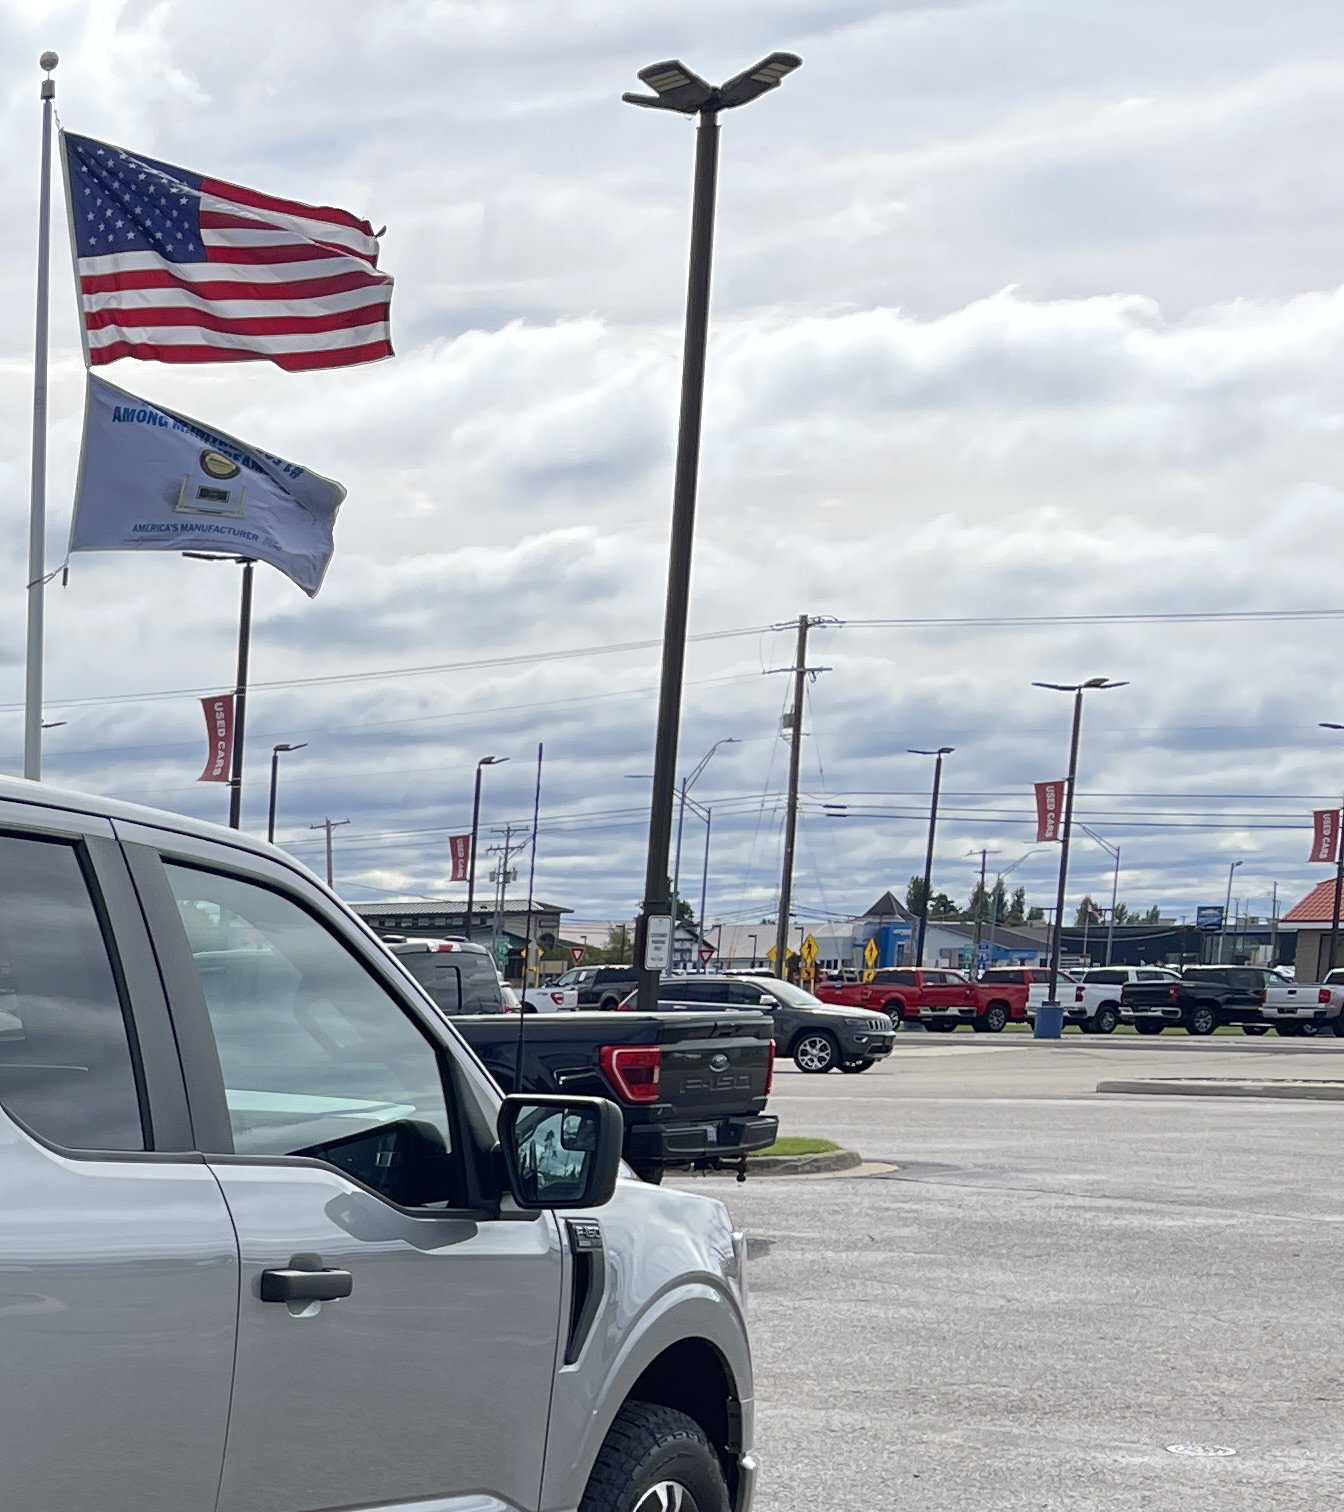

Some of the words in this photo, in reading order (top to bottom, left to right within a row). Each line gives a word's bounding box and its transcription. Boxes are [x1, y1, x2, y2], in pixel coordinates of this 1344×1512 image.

[112, 405, 168, 427] AMONG
[132, 523, 179, 533] AMERICA'S
[180, 523, 259, 542] MANUFACTURER
[214, 701, 226, 738] USED
[212, 740, 226, 776] CARS
[1045, 785, 1056, 811] USED
[1044, 812, 1056, 838] CARS
[1322, 813, 1332, 836] USED
[1318, 836, 1331, 859] CARS
